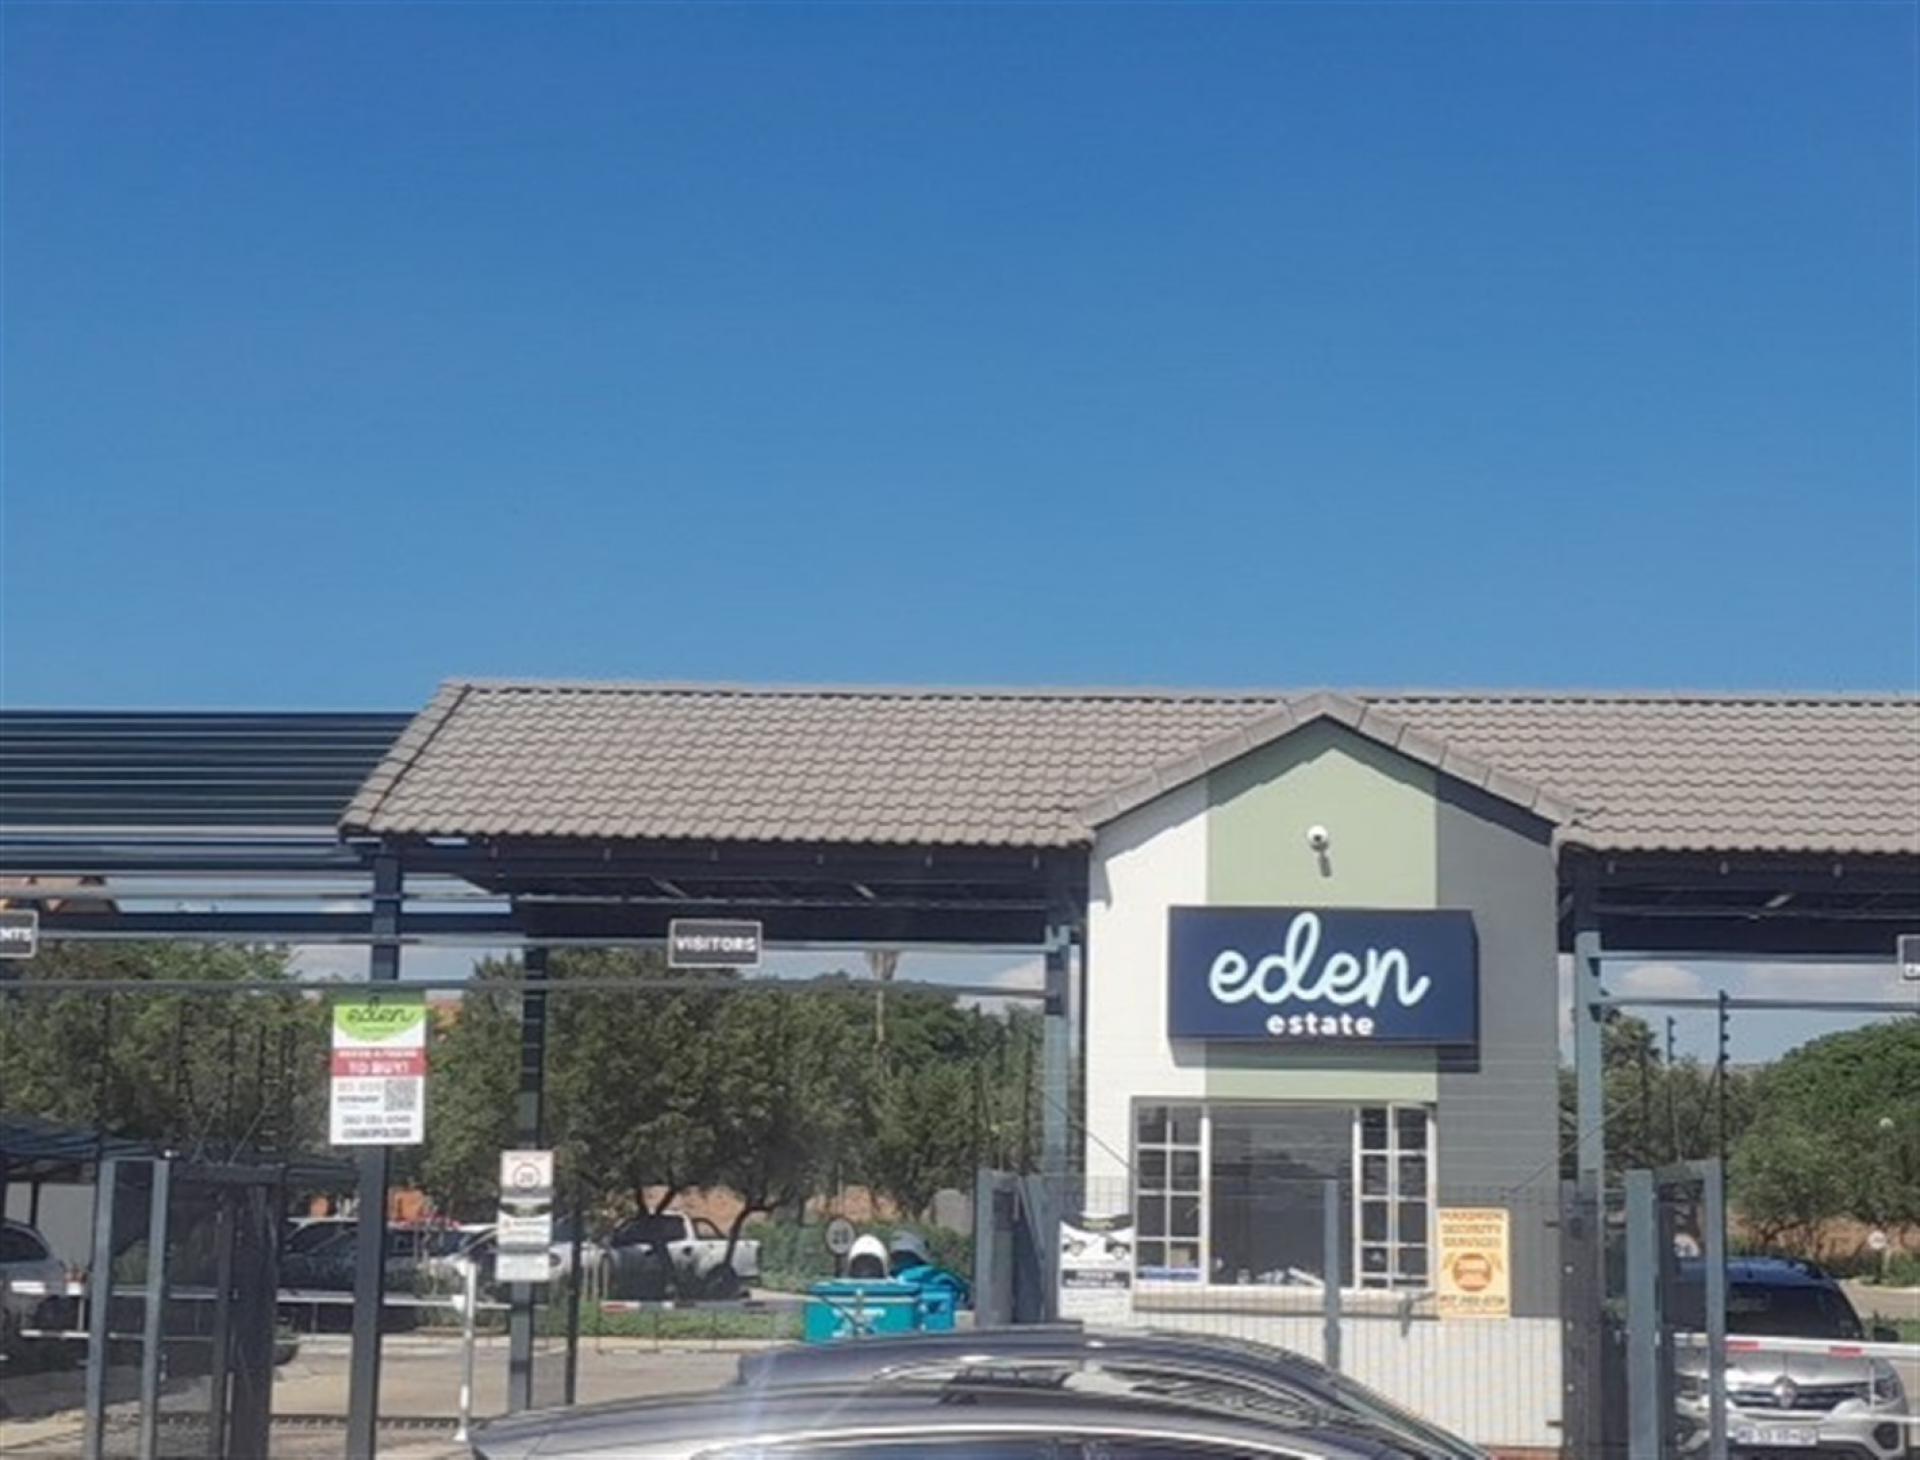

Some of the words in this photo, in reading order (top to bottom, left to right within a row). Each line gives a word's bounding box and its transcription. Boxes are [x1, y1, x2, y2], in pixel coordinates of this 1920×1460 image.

[677, 936, 755, 952] VISITORS
[1209, 911, 1431, 1007] eden
[347, 997, 415, 1022] eden
[1266, 1012, 1375, 1035] estate
